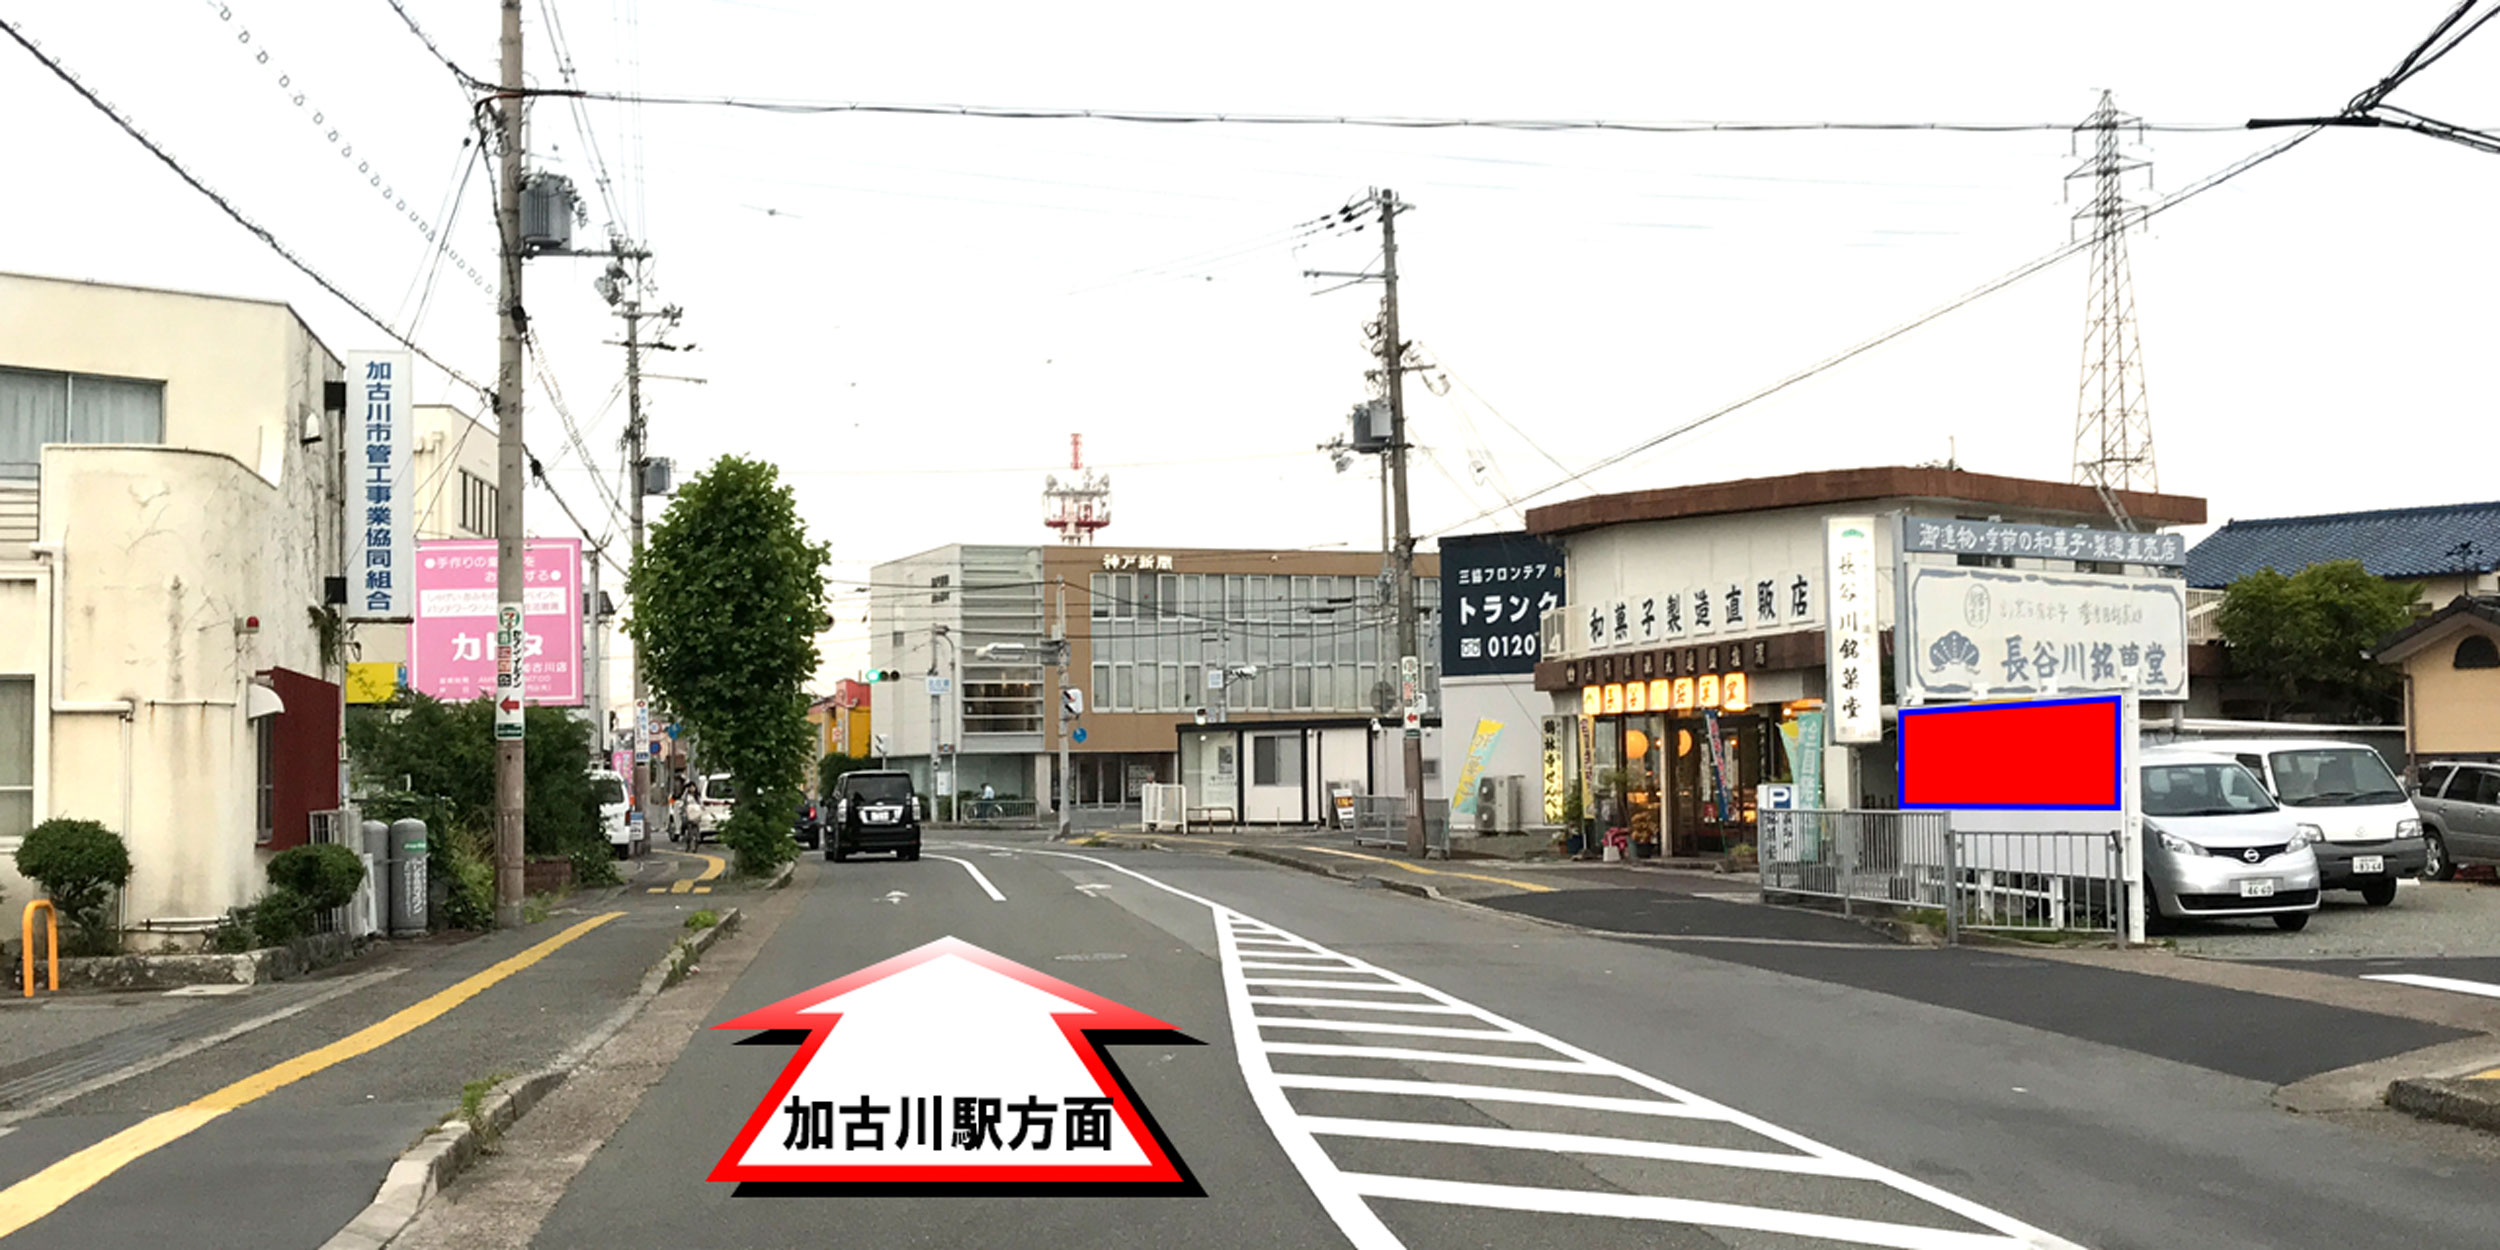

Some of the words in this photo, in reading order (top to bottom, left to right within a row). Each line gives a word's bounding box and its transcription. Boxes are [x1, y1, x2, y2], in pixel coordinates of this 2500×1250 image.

[366, 360, 392, 611] 加古川市管工事業協同組合
[1589, 574, 1808, 643] 和菓子製造直販店
